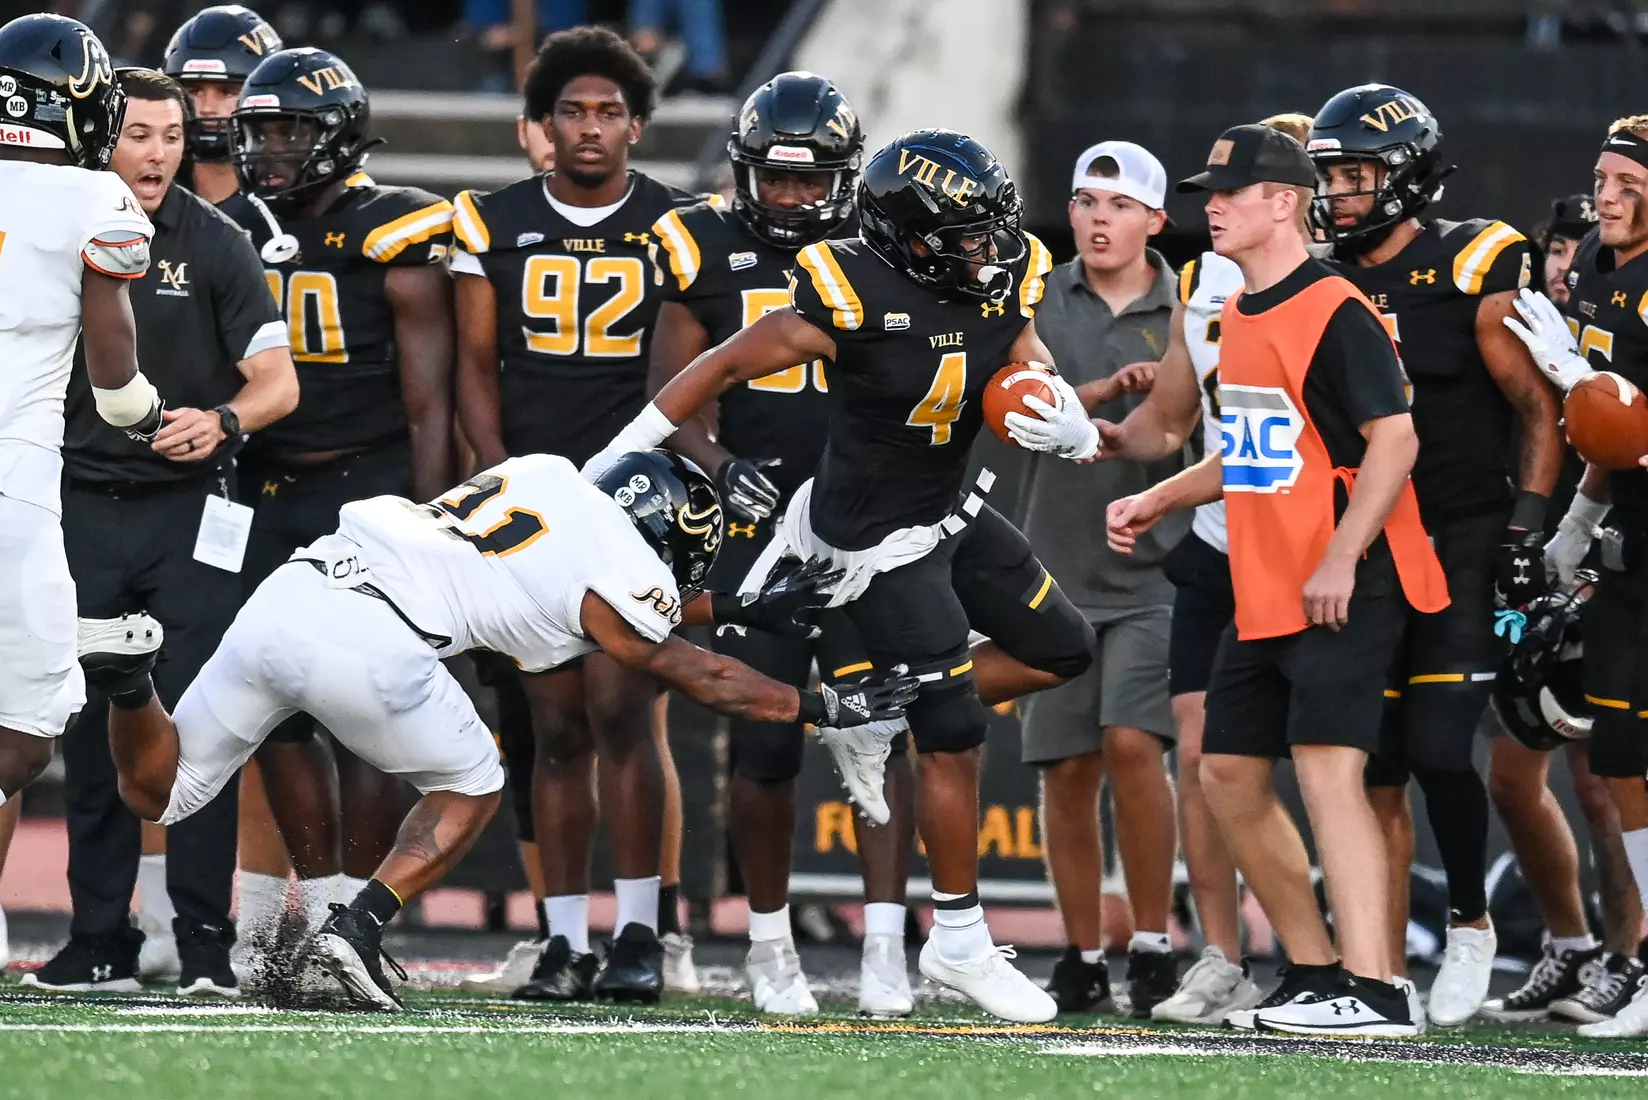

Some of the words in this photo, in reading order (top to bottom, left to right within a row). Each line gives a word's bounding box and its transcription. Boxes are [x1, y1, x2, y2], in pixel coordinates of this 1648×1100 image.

[9, 101, 26, 112] MB
[898, 148, 978, 207] VILLE
[562, 238, 606, 253] VILLE
[522, 254, 645, 357] 92
[886, 317, 909, 326] PSAC
[928, 331, 964, 349] VILLE
[905, 351, 968, 446] 4
[631, 476, 648, 491] MR
[616, 489, 633, 503] MB
[840, 698, 871, 718] adidas
